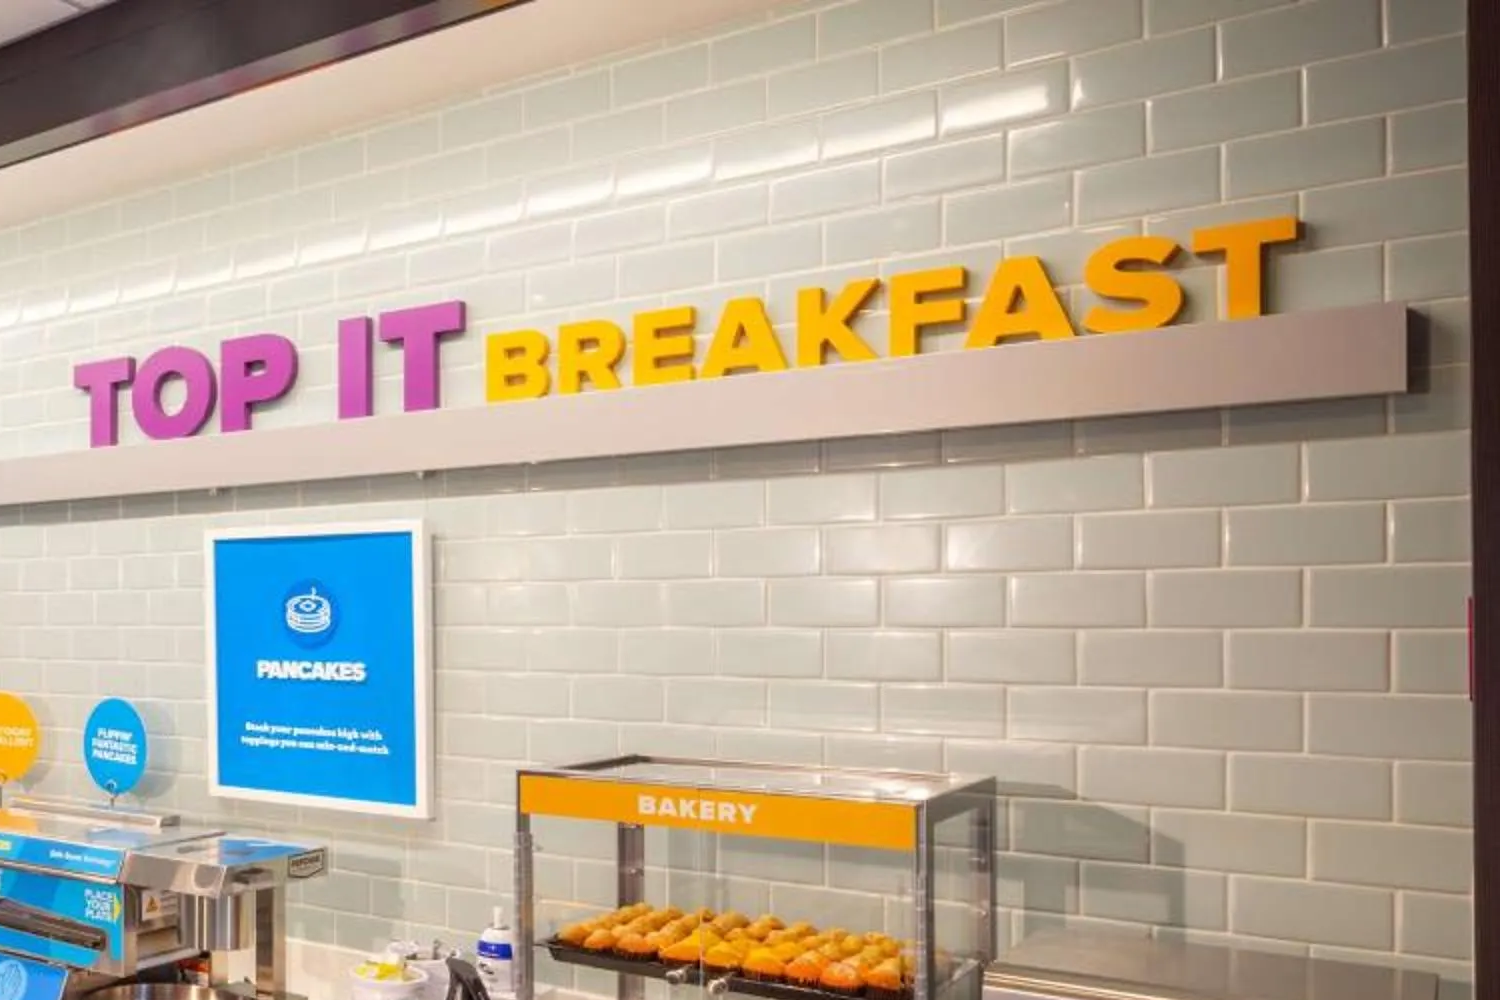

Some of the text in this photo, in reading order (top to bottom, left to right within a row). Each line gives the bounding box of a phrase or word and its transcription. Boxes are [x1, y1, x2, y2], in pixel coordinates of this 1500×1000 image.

[73, 216, 1306, 447] TOP IT BREAKFAST
[257, 660, 366, 682] PANCAKES
[638, 795, 756, 824] BAKERY
[84, 888, 115, 904] PLACE
[86, 899, 113, 914] YOUR
